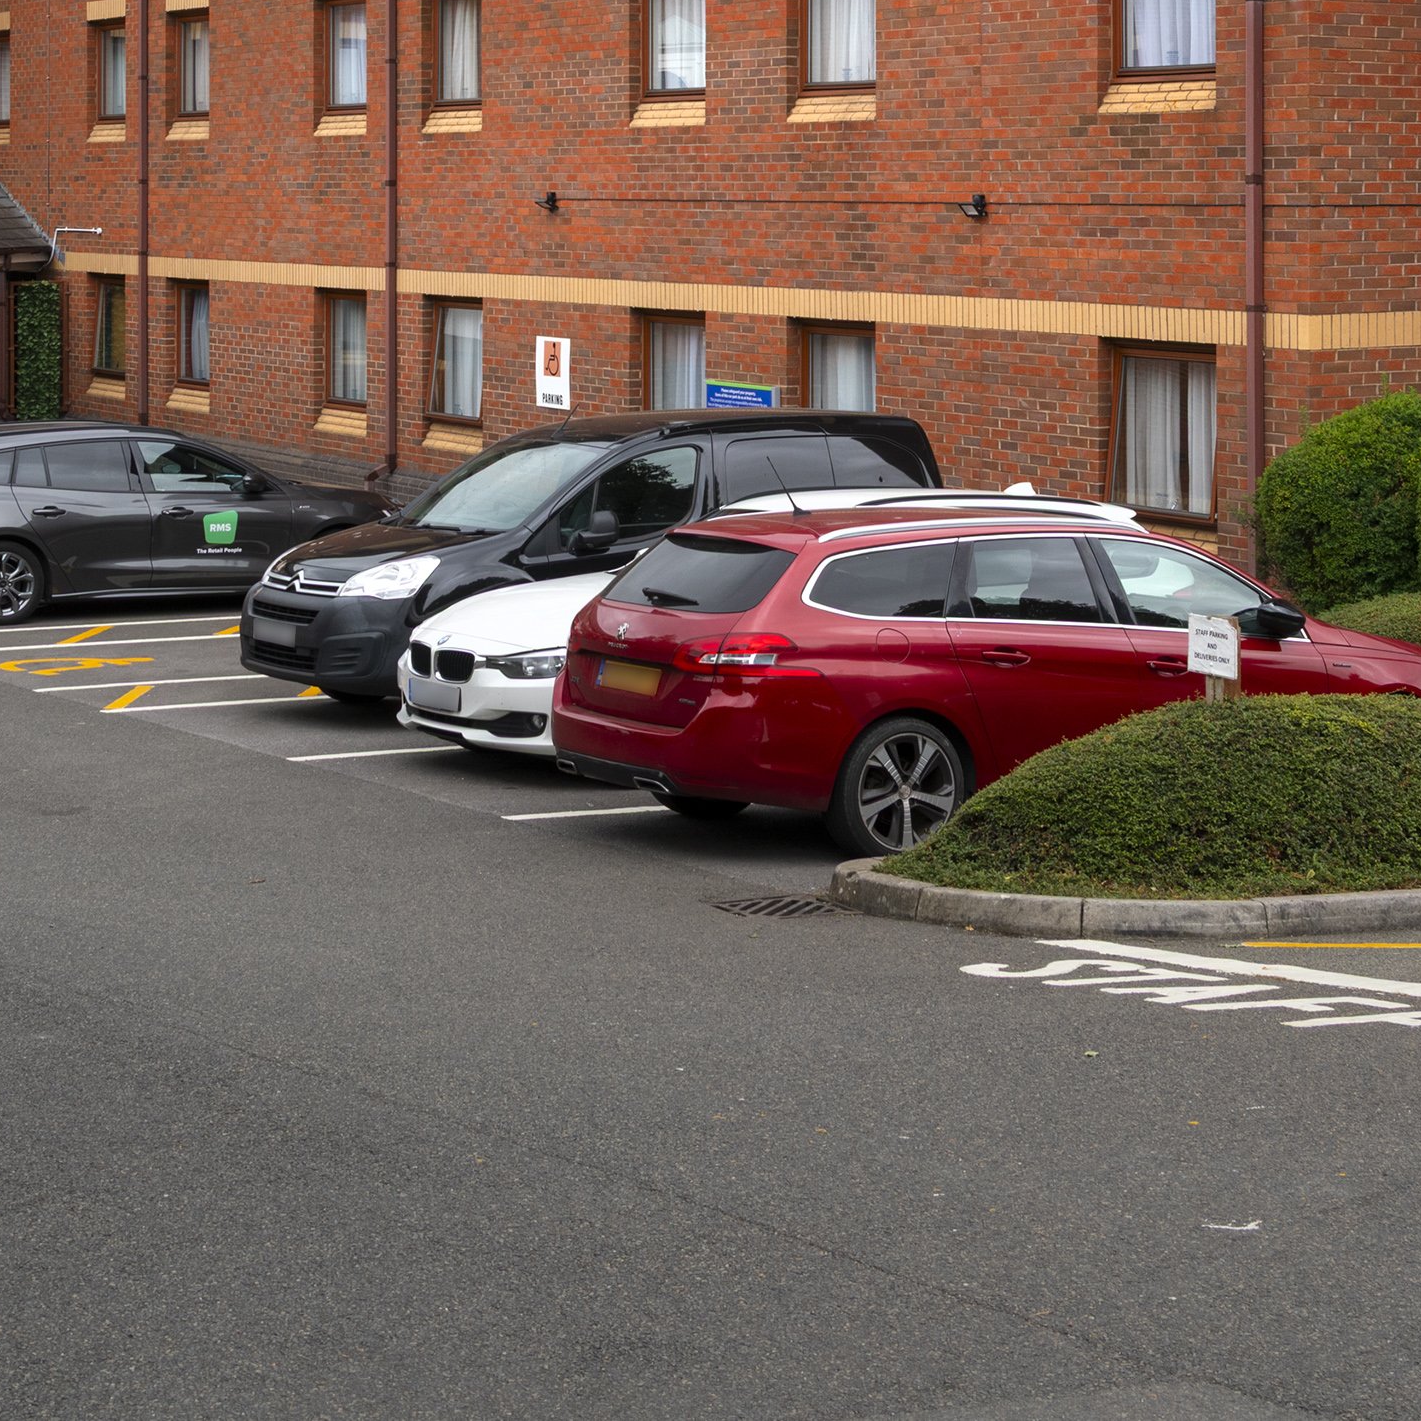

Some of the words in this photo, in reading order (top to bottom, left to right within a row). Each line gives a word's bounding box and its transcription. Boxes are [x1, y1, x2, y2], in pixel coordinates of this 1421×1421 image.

[542, 392, 563, 406] PARKING
[209, 523, 232, 532] RMS
[224, 546, 243, 554] People
[1195, 628, 1209, 638] STAFF
[1209, 630, 1229, 640] PARKING
[1207, 642, 1218, 650] AND
[1194, 651, 1218, 662] DELIVERIES
[1218, 656, 1230, 665] ONLY
